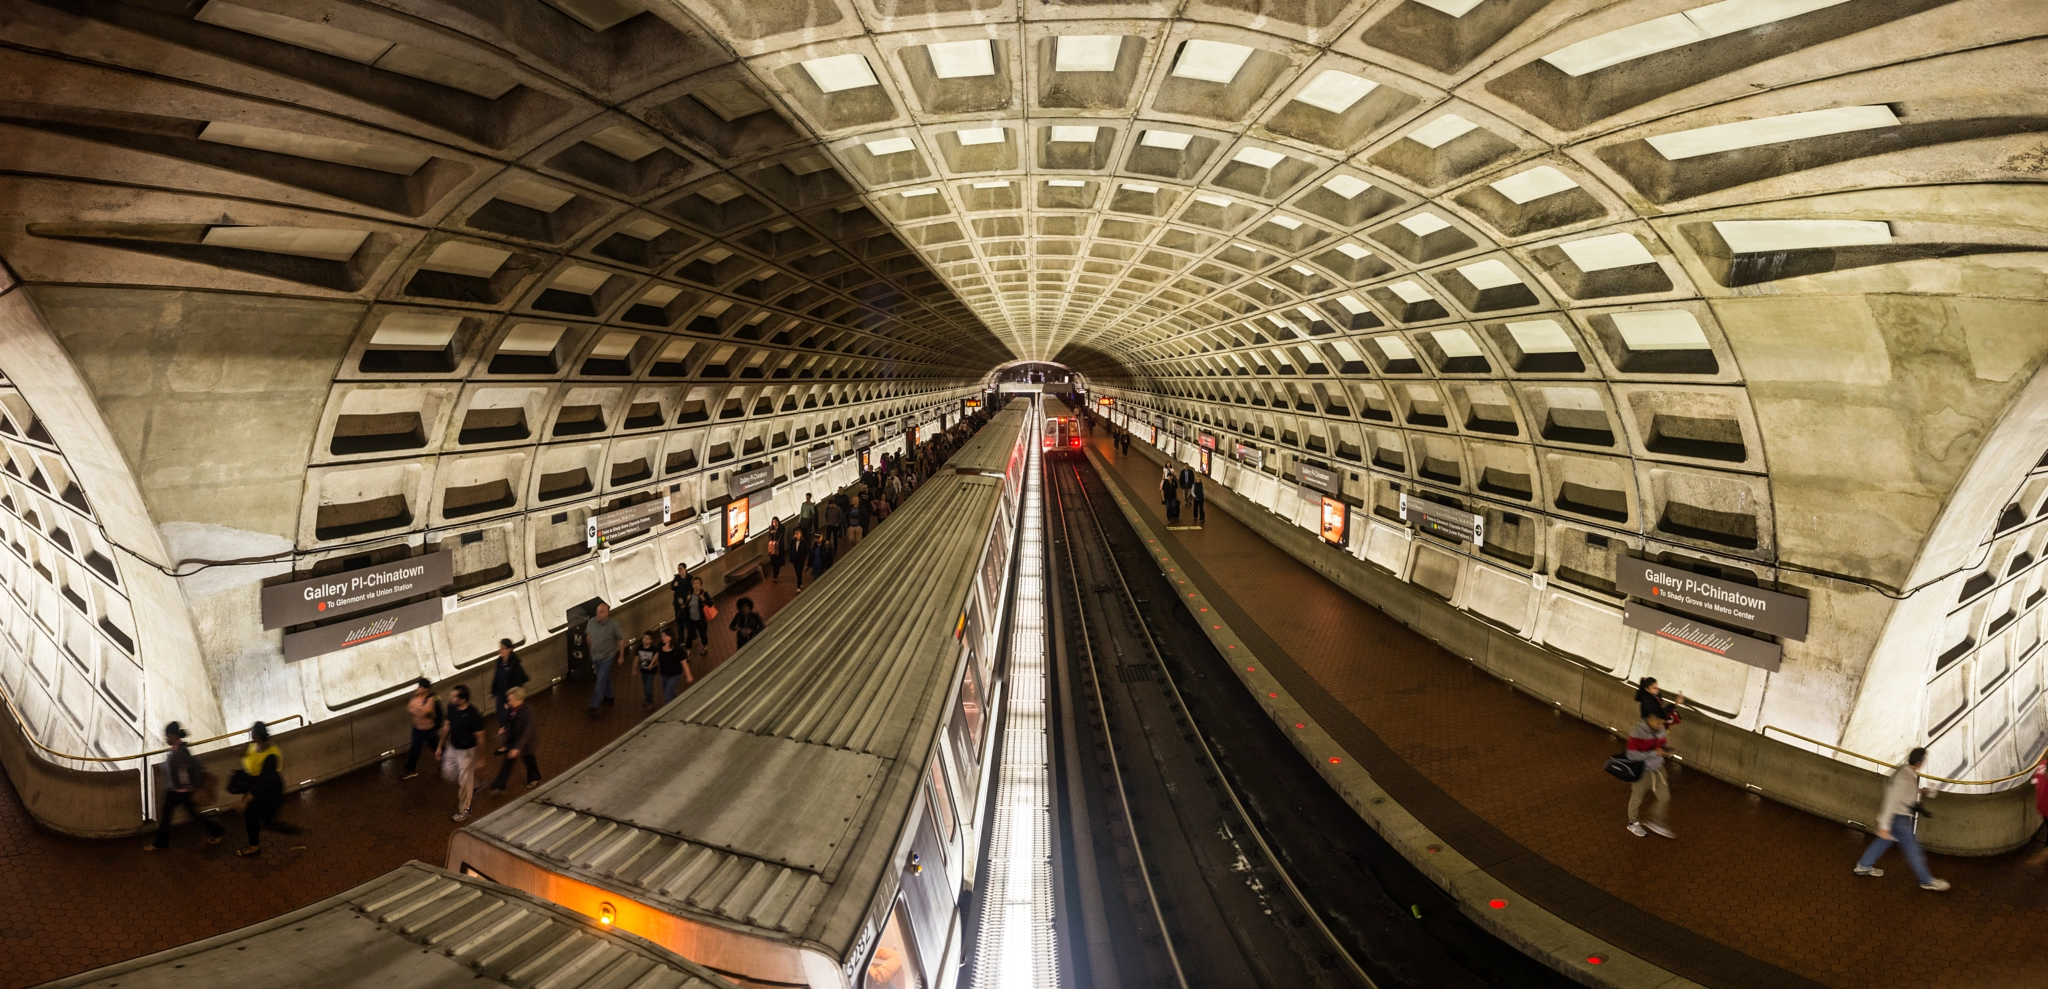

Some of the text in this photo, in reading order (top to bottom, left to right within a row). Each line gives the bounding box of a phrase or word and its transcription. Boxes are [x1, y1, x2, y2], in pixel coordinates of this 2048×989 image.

[304, 564, 424, 601] Gallery Pl-Chinatown
[327, 582, 413, 609] To Glenmont via Union Station
[1645, 568, 1766, 611] Gallery Pl-Chinatown
[1659, 589, 1755, 621] To Shady Grove via Metro Center
[846, 926, 871, 978] 3282
